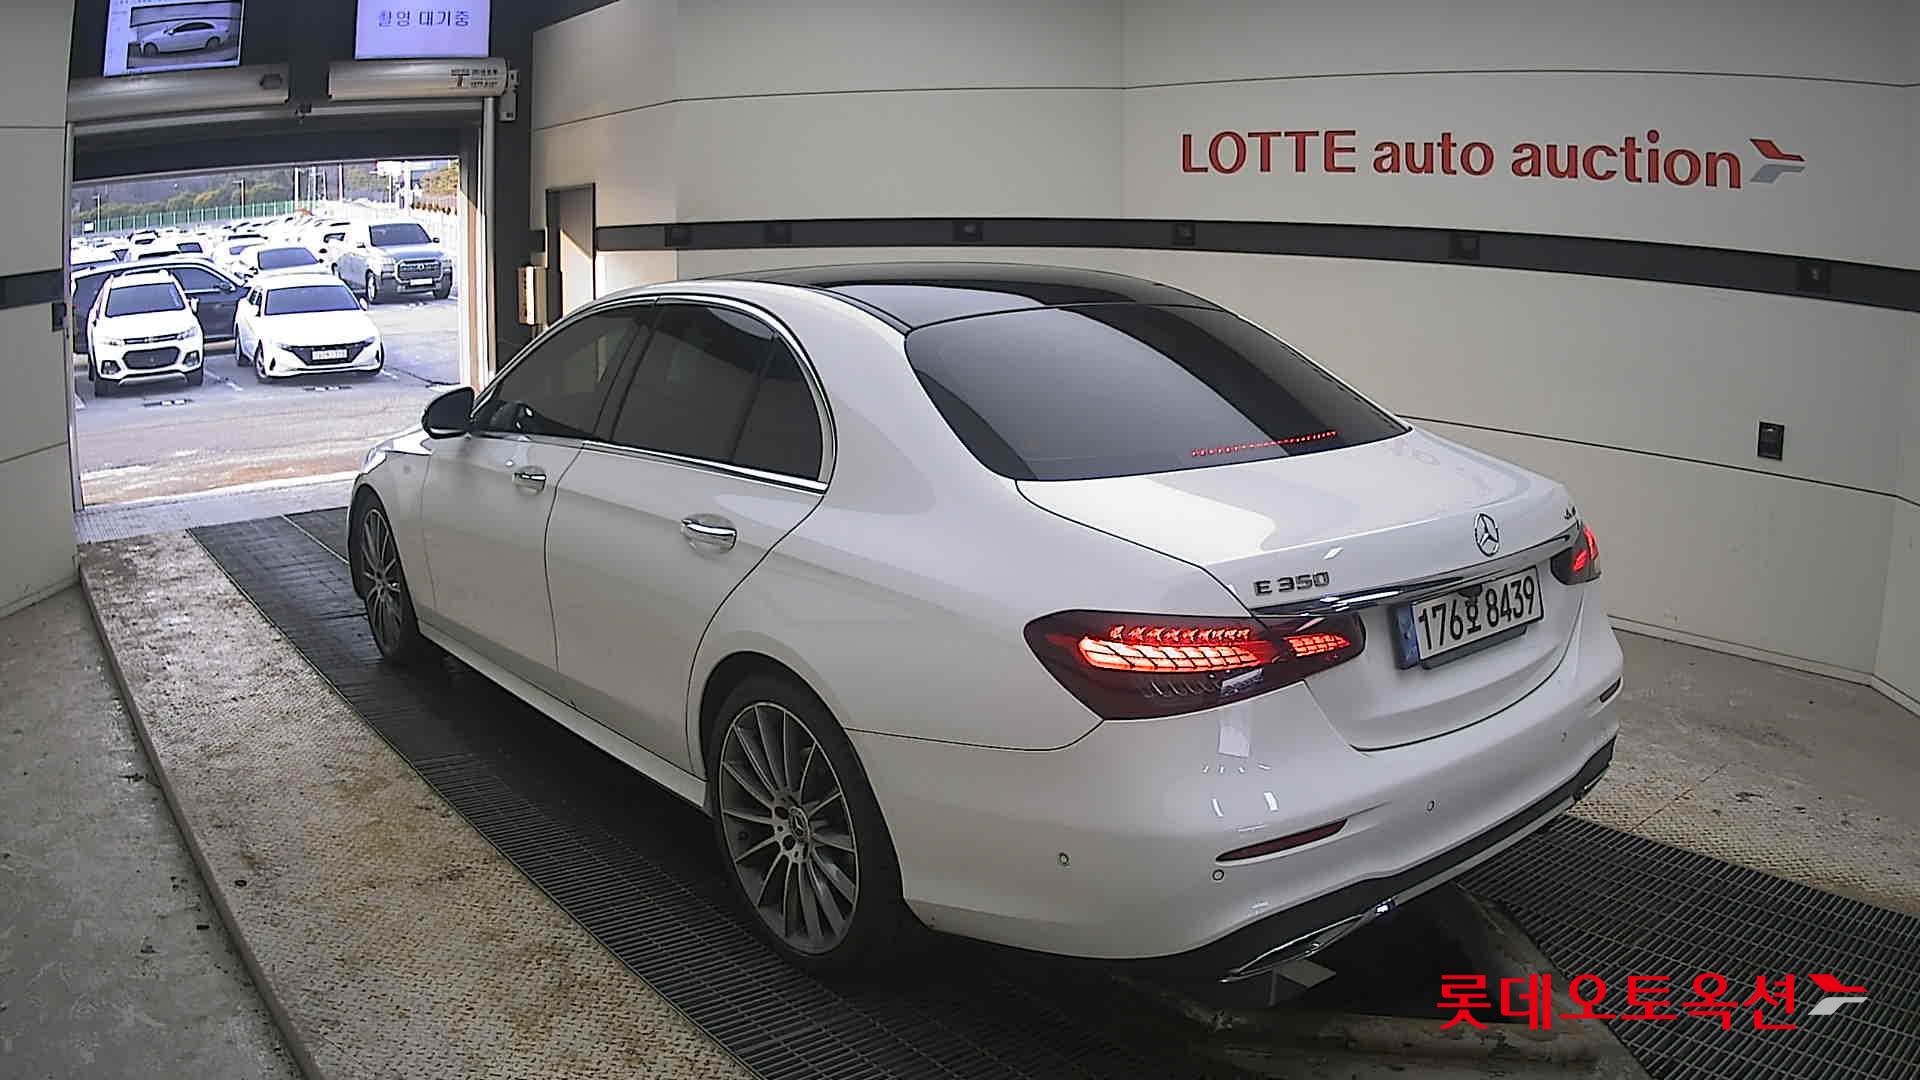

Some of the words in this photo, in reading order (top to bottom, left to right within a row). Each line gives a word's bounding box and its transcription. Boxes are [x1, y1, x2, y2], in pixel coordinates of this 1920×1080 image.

[419, 10, 469, 27] 대기중
[1182, 130, 1356, 174] LOTTE
[1373, 132, 1494, 176] auto
[1511, 129, 1741, 189] auction
[1254, 580, 1273, 597] E
[1277, 571, 1330, 592] 350
[1485, 575, 1535, 628] 8439
